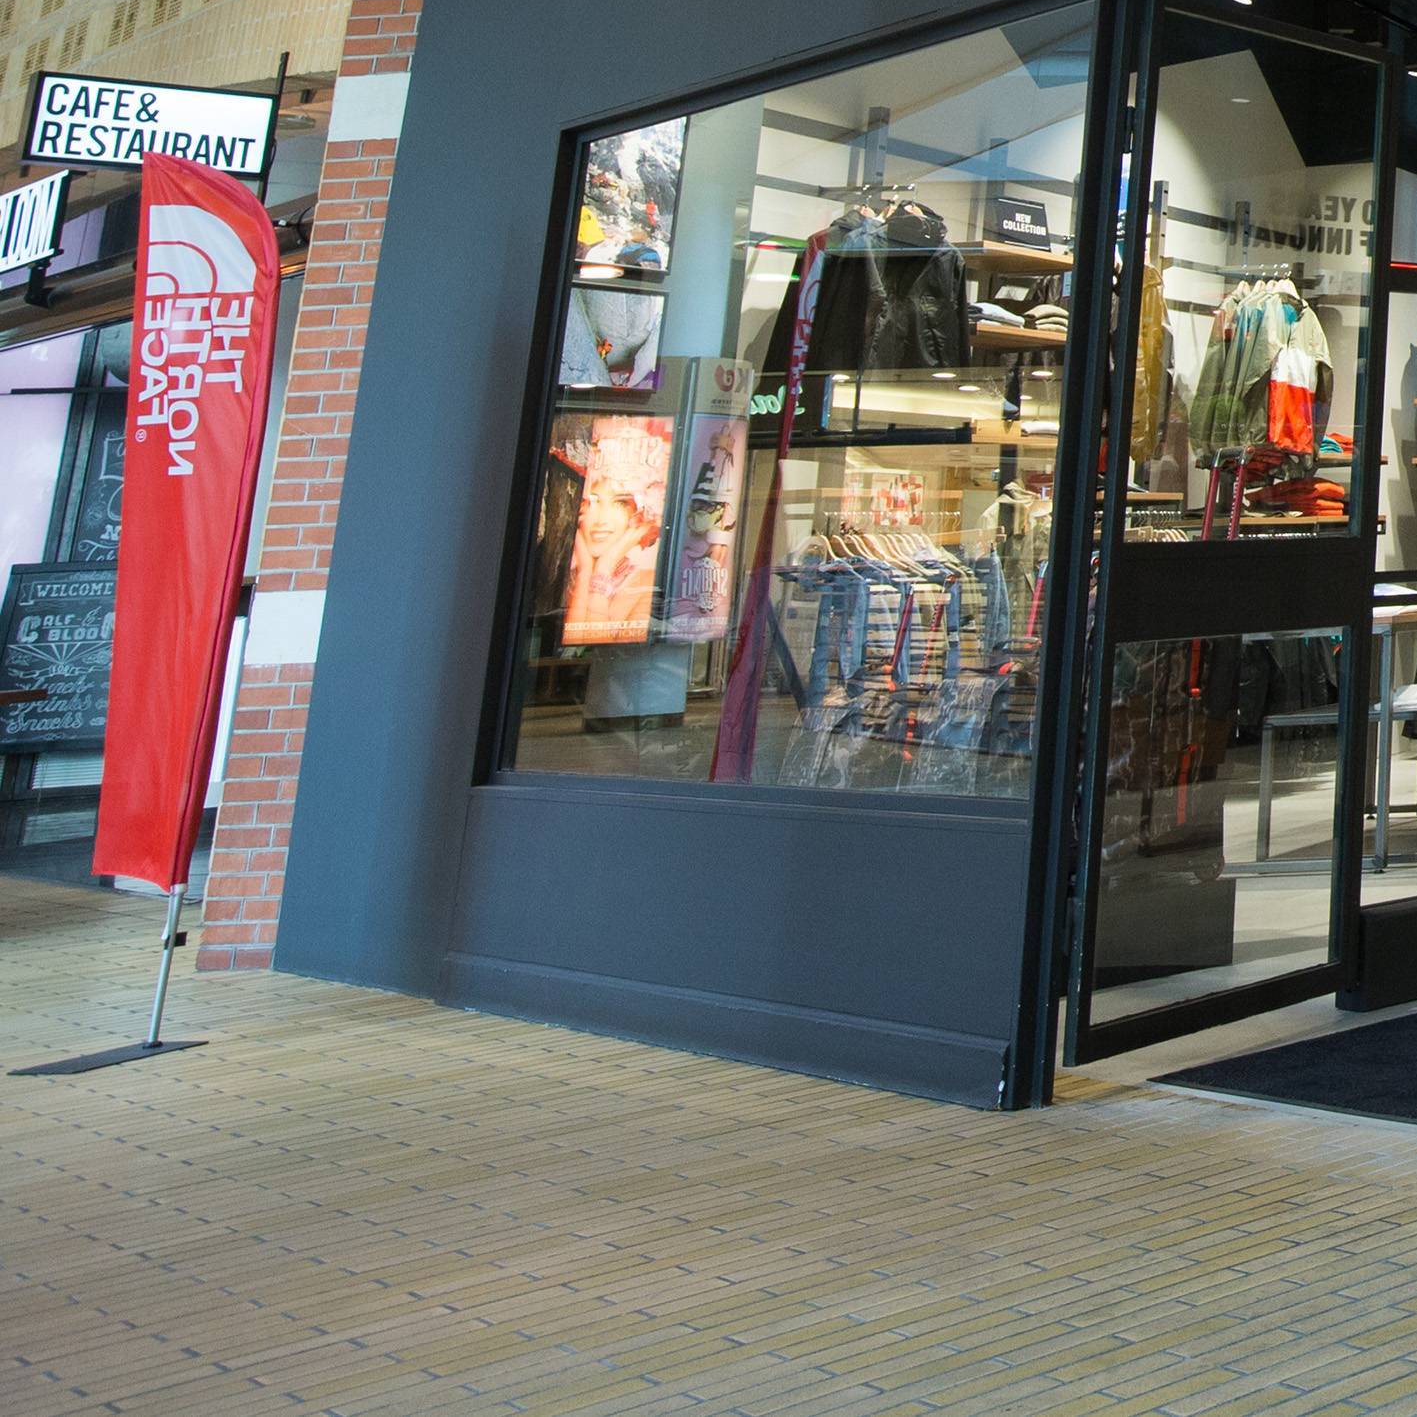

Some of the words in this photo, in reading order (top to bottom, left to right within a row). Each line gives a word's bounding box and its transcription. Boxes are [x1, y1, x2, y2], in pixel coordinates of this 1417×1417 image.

[37, 121, 256, 169] RESTAURANT
[1015, 212, 1032, 224] NEW
[1003, 219, 1047, 237] COLLECTION
[37, 582, 114, 598] WELCOME
[6, 711, 84, 734] Snacks
